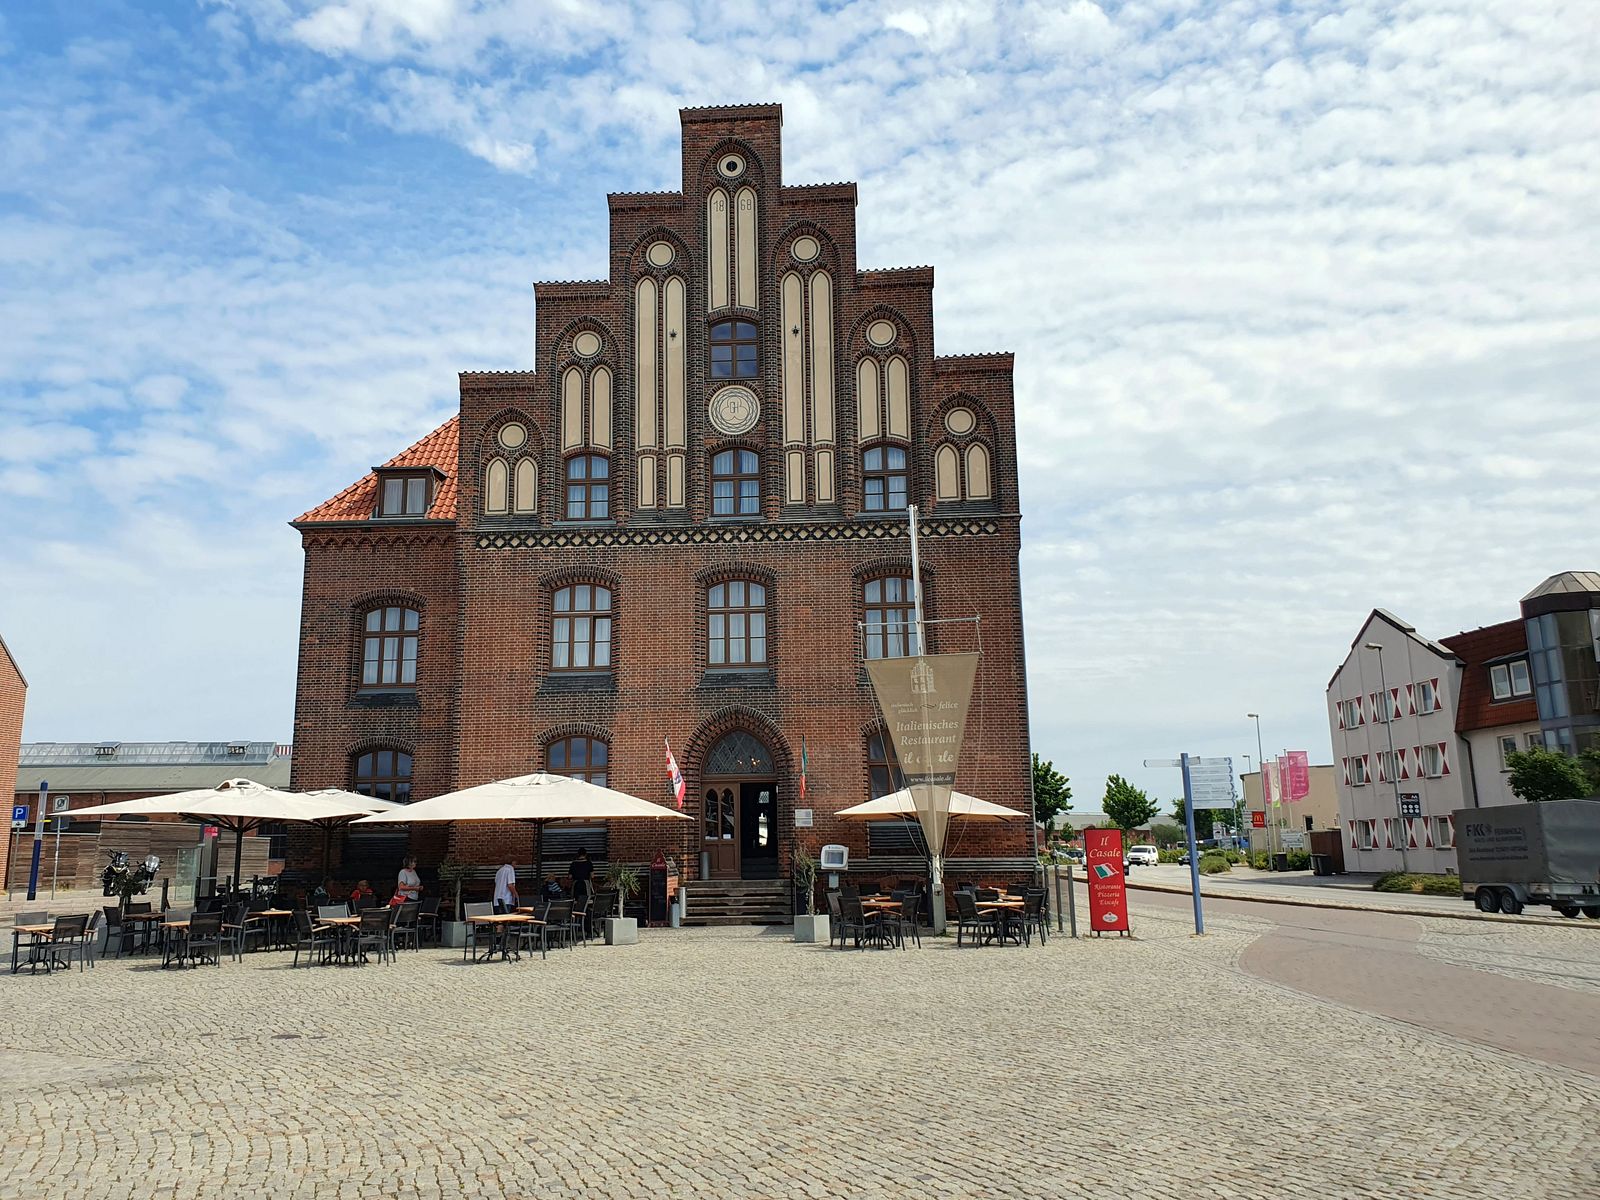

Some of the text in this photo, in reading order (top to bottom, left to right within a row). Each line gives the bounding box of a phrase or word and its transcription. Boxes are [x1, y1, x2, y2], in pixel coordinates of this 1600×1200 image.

[713, 199, 752, 212] 18 68
[938, 701, 959, 712] felice
[895, 719, 960, 732] Italienisches
[900, 734, 957, 746] Restaurant
[15, 807, 24, 819] P
[1100, 836, 1110, 846] Il
[1089, 847, 1121, 858] Casale
